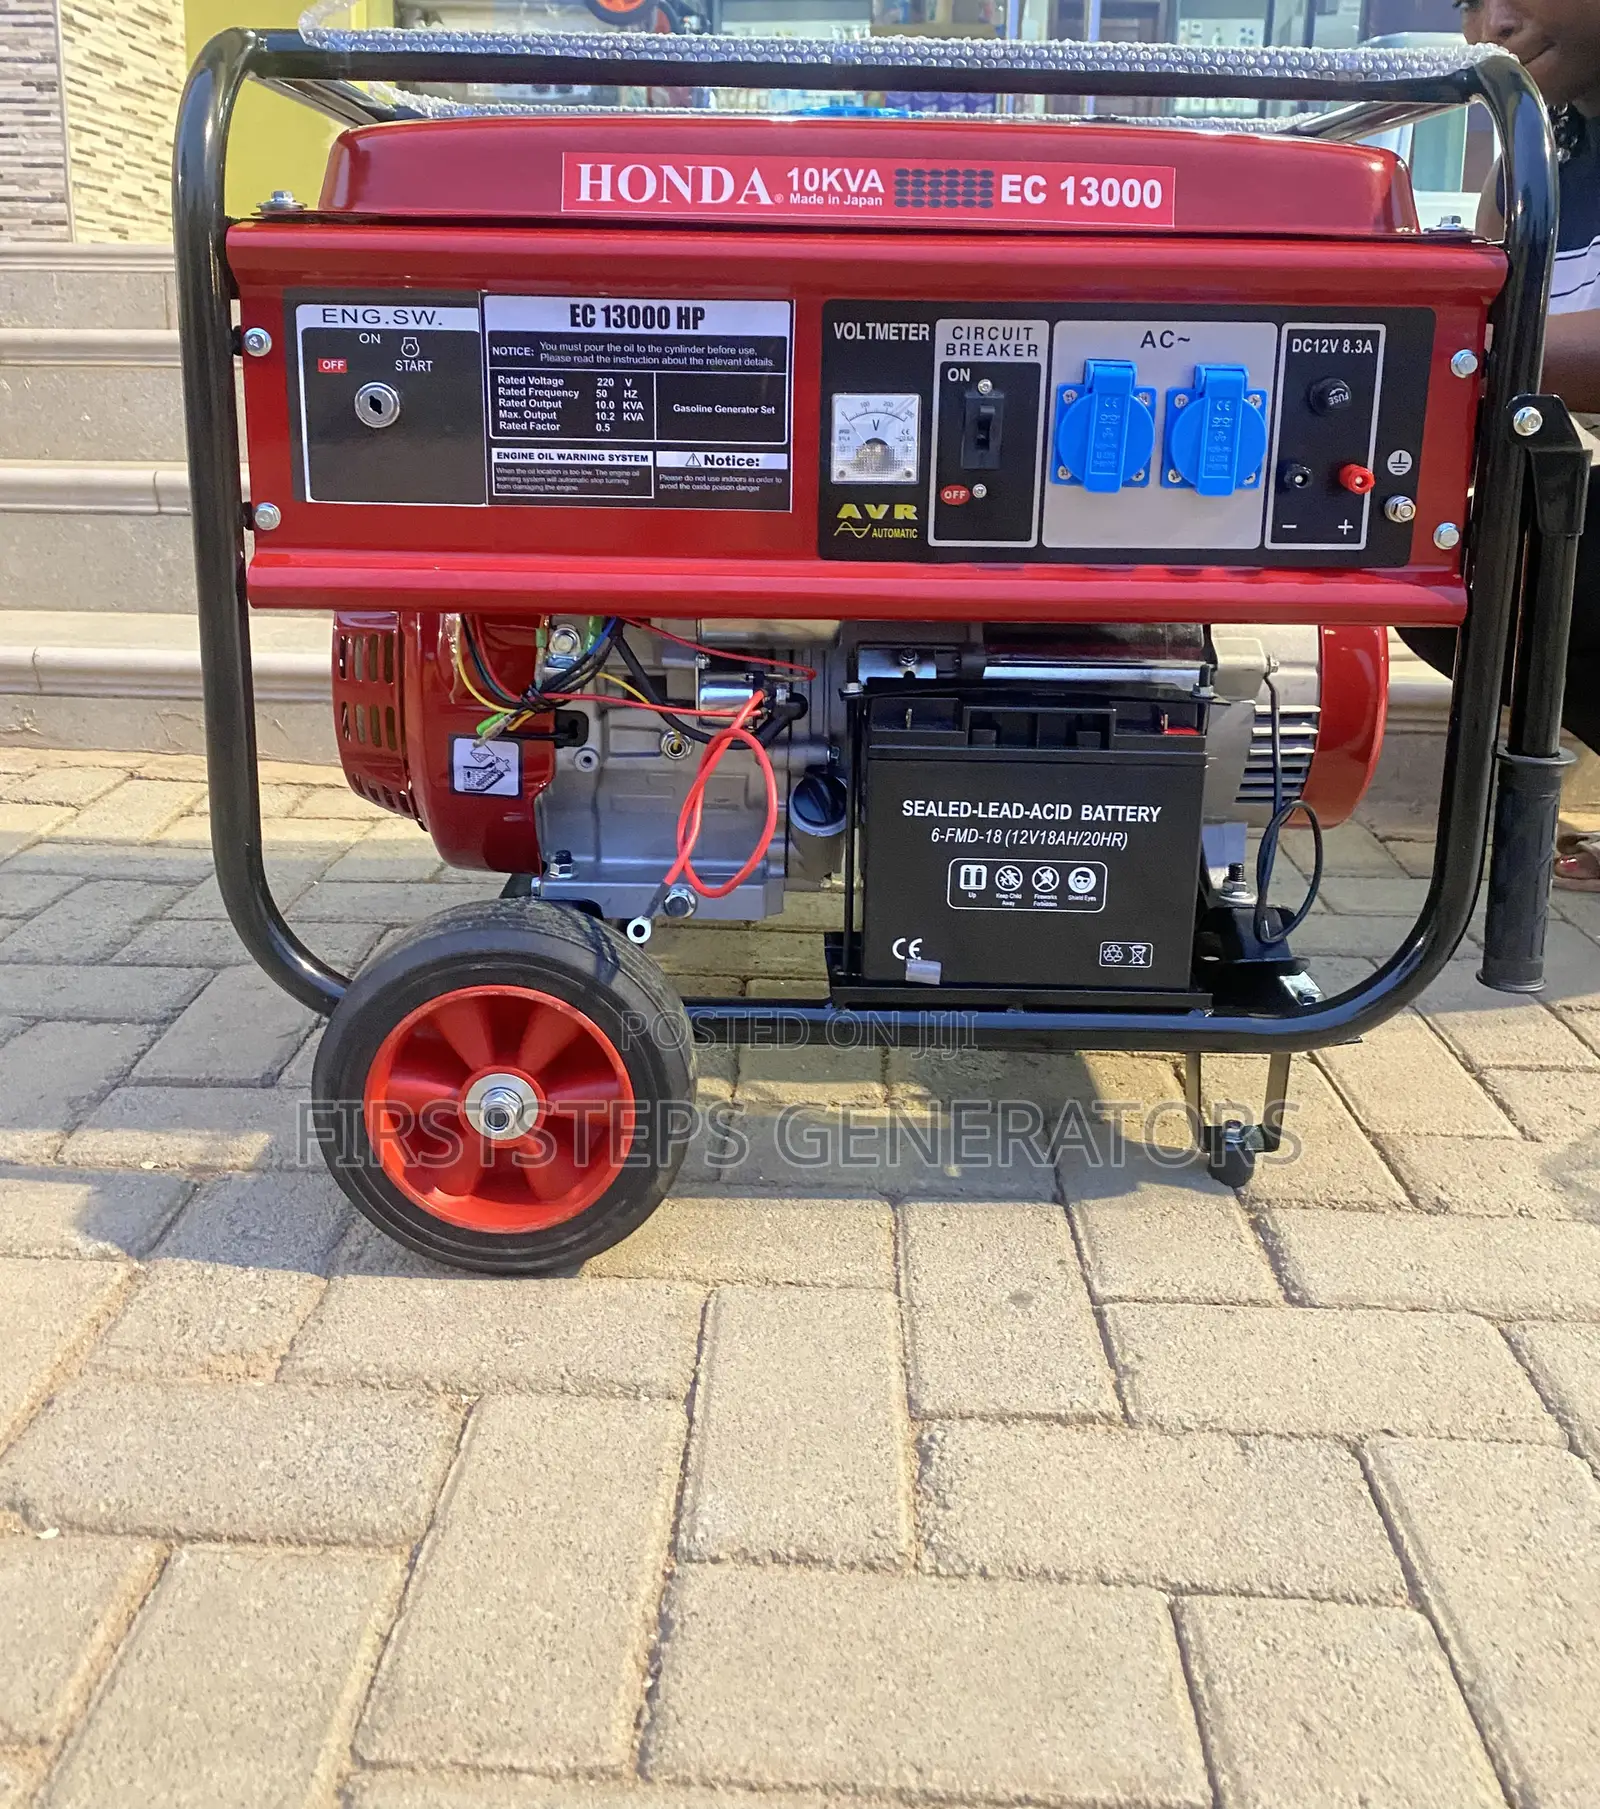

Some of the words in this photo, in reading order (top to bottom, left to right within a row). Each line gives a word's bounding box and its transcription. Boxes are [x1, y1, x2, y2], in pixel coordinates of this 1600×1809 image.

[575, 163, 775, 206] HONDA
[786, 167, 885, 194] 10KVA
[1000, 174, 1047, 202] EC
[1059, 177, 1162, 209] 13000
[789, 193, 824, 205] Made
[827, 193, 840, 206] in
[843, 194, 884, 208] Japan
[322, 308, 443, 326] ENG.SW.
[569, 303, 596, 328] EC
[600, 304, 670, 329] 13000
[676, 306, 706, 330] HP
[359, 332, 381, 344] ON
[833, 322, 930, 341] VOLTMETER
[952, 326, 1033, 341] CIRCUIT
[492, 346, 535, 357] NOTICE:
[539, 341, 557, 352] You
[559, 341, 582, 352] must
[584, 343, 605, 354] pour
[607, 343, 622, 352] the
[624, 343, 635, 352] oil
[637, 343, 646, 353] to
[648, 344, 662, 353] the
[707, 345, 736, 355] before
[945, 343, 1038, 357] BREAKER
[1292, 338, 1338, 353] DC12V
[1342, 340, 1373, 354] 8.3A
[322, 360, 345, 370] OFF
[395, 359, 433, 372] START
[540, 353, 572, 363] Please
[573, 354, 594, 363] read
[596, 354, 611, 364] the
[613, 354, 660, 365] instruction
[661, 356, 688, 365] about
[689, 356, 704, 366] the
[706, 357, 742, 366] relevant
[744, 357, 775, 367] details.
[498, 375, 526, 385] Rated
[528, 376, 564, 387] Voltage
[597, 378, 614, 387] 220
[625, 379, 632, 387] V
[947, 368, 971, 382] ON
[498, 387, 526, 397] Rated
[528, 388, 580, 399] Frequency
[596, 390, 608, 398] 50
[624, 390, 638, 399] HZ
[1328, 391, 1349, 406] FUSE
[499, 398, 527, 408] Rated
[529, 399, 563, 410] Output
[596, 401, 615, 410] 10.0
[623, 401, 644, 411] KVA
[673, 404, 713, 413] Gasoline
[714, 405, 759, 414] Generator
[760, 405, 776, 415] Set
[499, 410, 521, 419] Max.
[523, 410, 557, 421] Output
[596, 412, 615, 421] 10.2
[623, 413, 644, 422] KVA
[500, 421, 528, 431] Rated
[530, 422, 561, 431] Factor
[596, 423, 611, 432] 0.5
[872, 419, 880, 432] V
[496, 452, 535, 460] ENGINE
[537, 453, 554, 461] OIL
[556, 453, 605, 461] WARNING
[608, 454, 649, 462] SYSTEM
[703, 454, 760, 467] Notice:
[496, 467, 515, 475] When
[609, 470, 631, 478] engine
[659, 473, 683, 482] Please
[684, 474, 694, 482] do
[721, 475, 747, 483] indoors
[496, 476, 522, 484] warning
[558, 476, 589, 484] automatic
[590, 477, 605, 485] stop
[496, 482, 512, 490] from
[512, 484, 544, 492] damaging
[711, 484, 735, 492] poison
[736, 485, 760, 493] danger
[944, 491, 966, 500] OFF
[836, 504, 918, 521] AVR
[871, 528, 918, 539] AUTOMATIC
[902, 800, 1072, 821] SEALED-LEAD-ACID
[1080, 805, 1162, 822] BATTERY
[931, 828, 1002, 845] 6-FMD-18
[1004, 829, 1128, 850] (12V18AH/20HR)
[892, 937, 923, 961] CE
